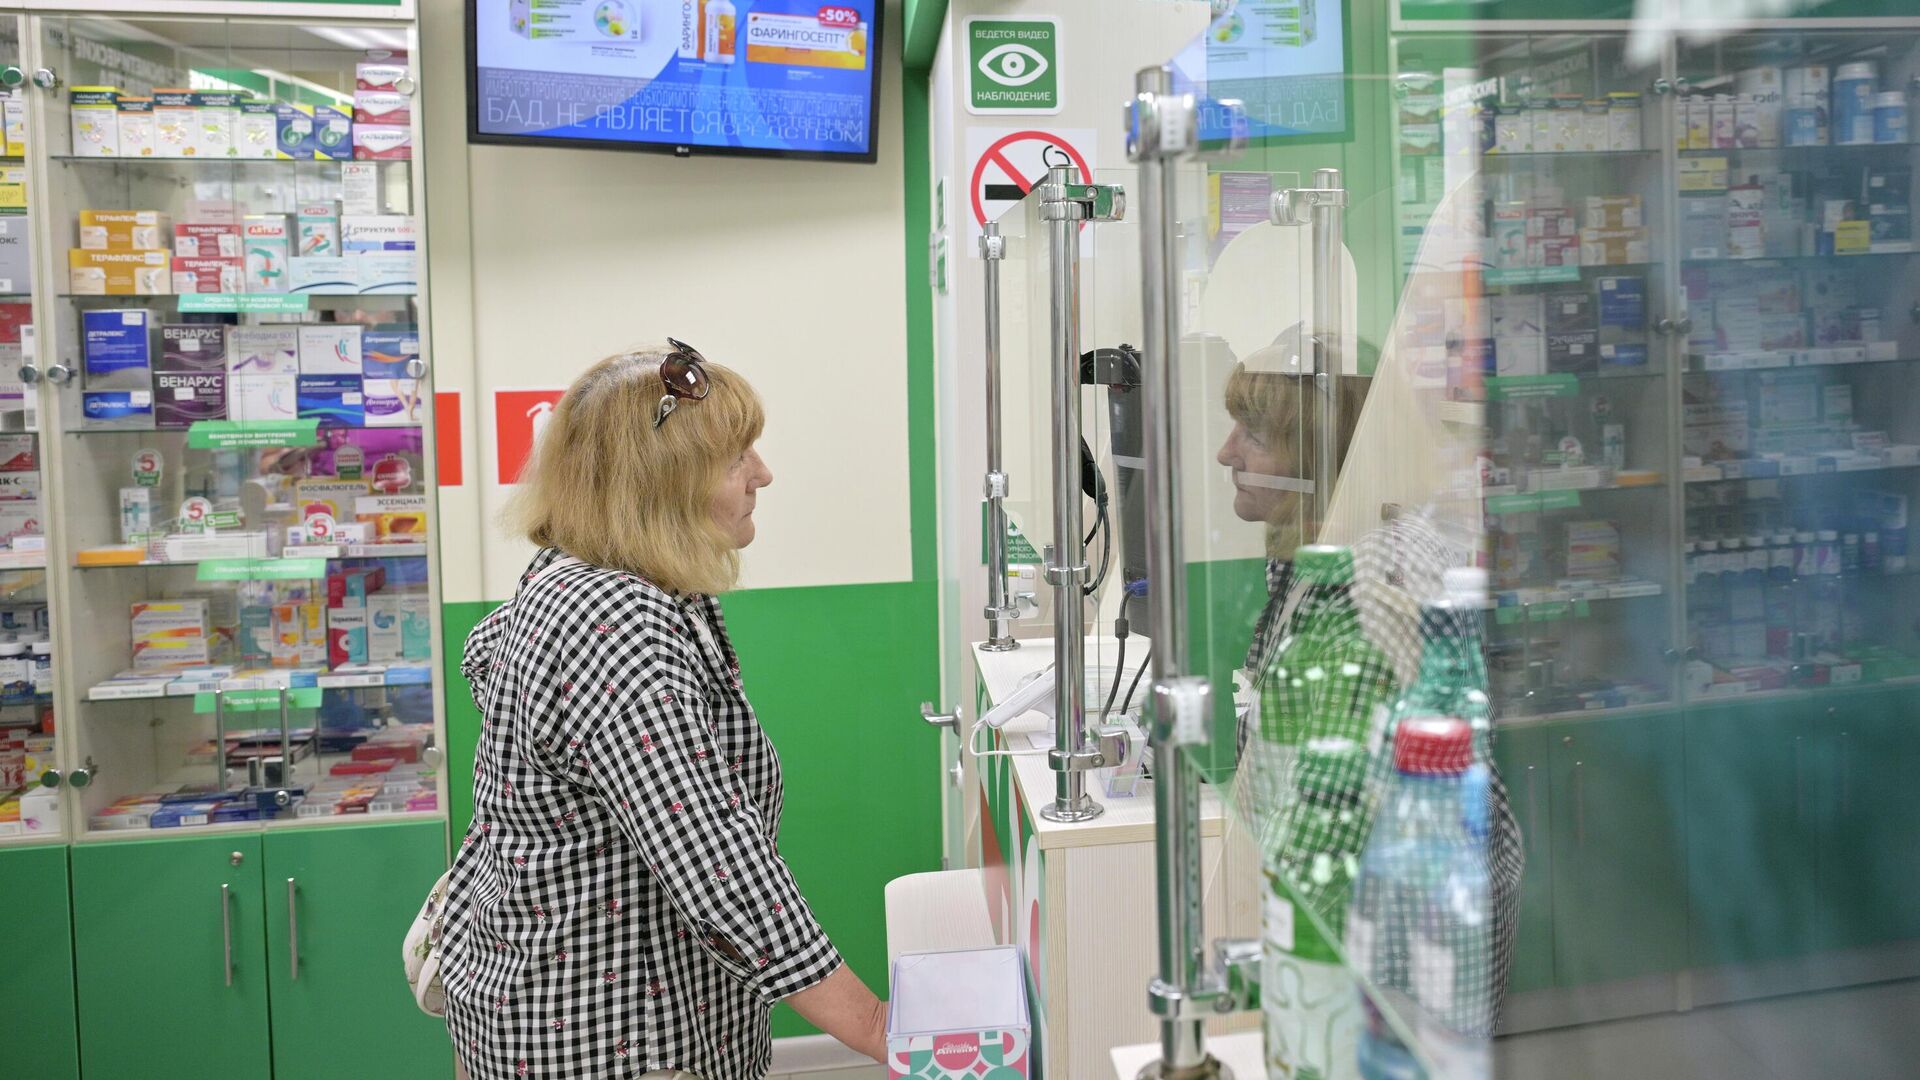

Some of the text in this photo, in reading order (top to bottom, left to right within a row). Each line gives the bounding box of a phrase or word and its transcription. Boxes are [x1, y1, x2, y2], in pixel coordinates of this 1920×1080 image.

[819, 7, 857, 23] -50%
[750, 27, 845, 44] ФАРИНГОСЕПТ
[975, 29, 1050, 40] ВЕДЕТСЯ ВИДЕО
[976, 91, 1051, 102] НАБЛЮДЕНИЕ
[487, 97, 721, 135] БАД. НЕ ЯВЛЯЕТСЯ
[353, 226, 396, 235] СТРУКТУМ
[90, 253, 145, 263] ТЕРАФЛЕКС
[163, 328, 221, 339] ВЕНАРУС
[160, 376, 222, 388] ВЕНАРУС
[300, 483, 368, 492] ФОСФАЛЮГЕЛЬ
[377, 498, 426, 506] ЭССЕНЦИАЛ
[188, 500, 204, 519] 5
[312, 518, 329, 537] 5
